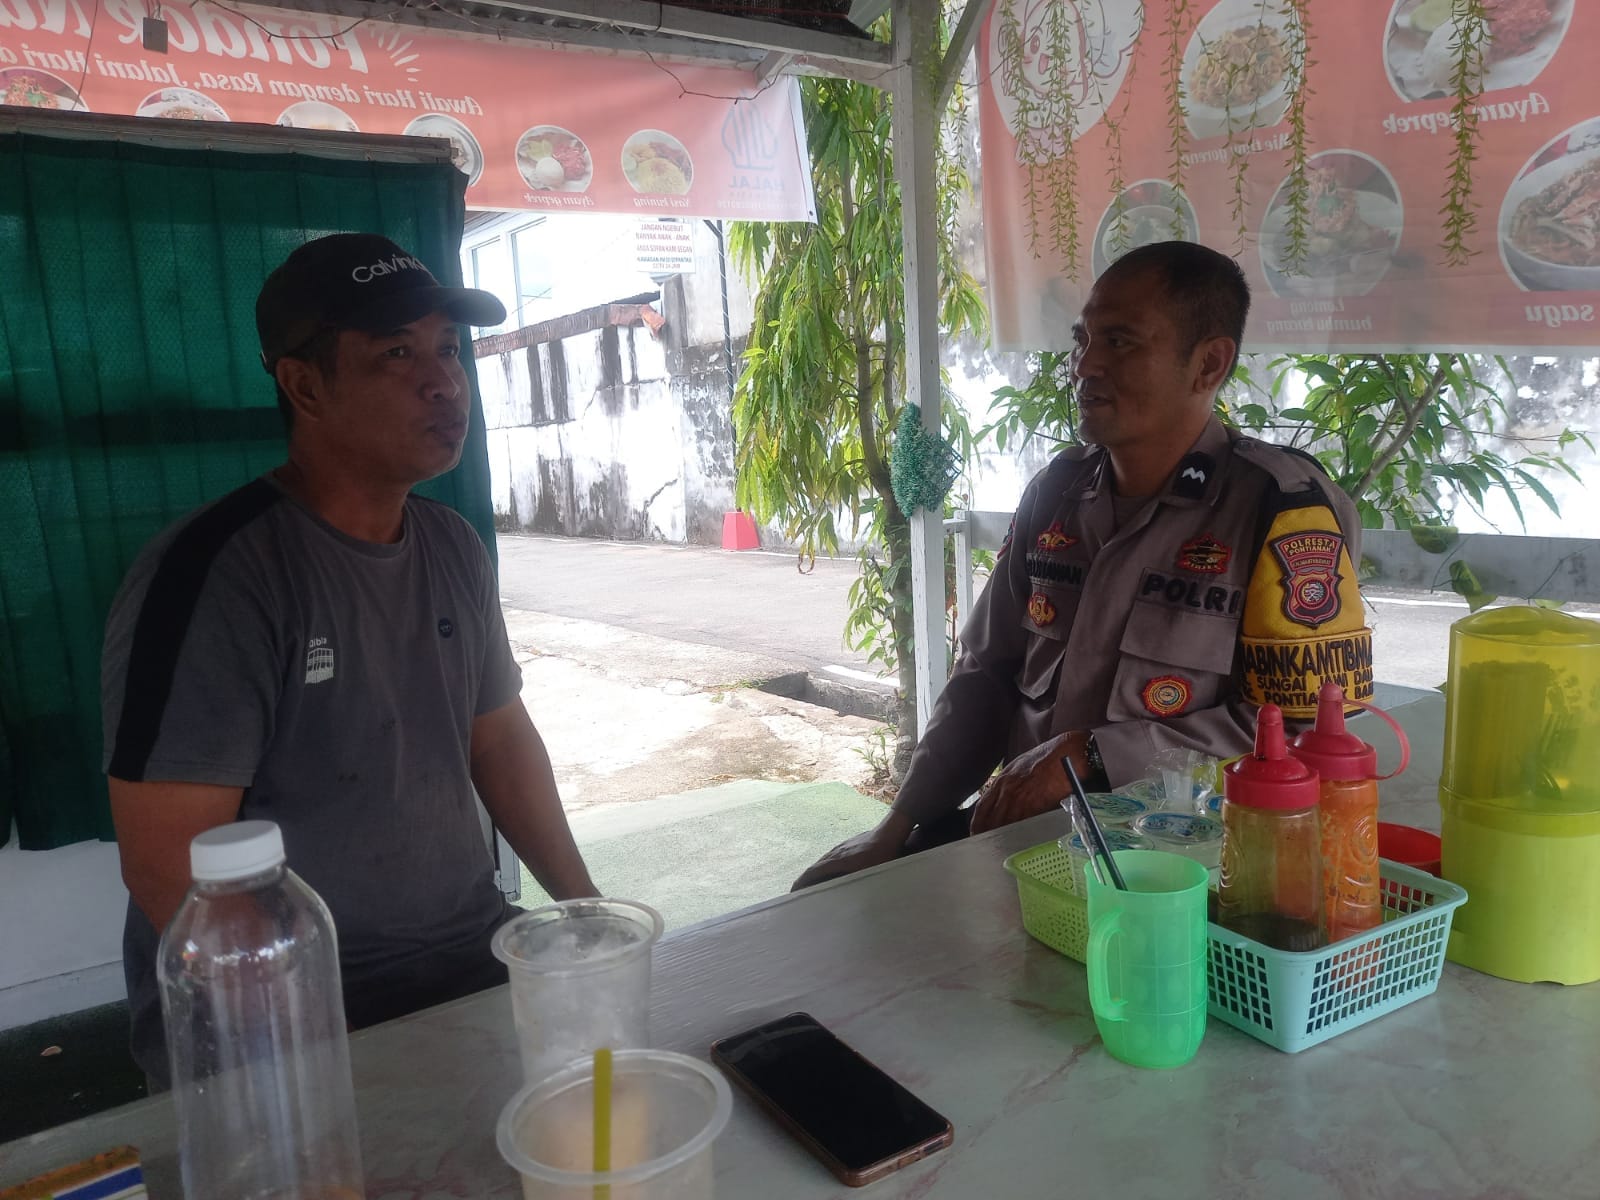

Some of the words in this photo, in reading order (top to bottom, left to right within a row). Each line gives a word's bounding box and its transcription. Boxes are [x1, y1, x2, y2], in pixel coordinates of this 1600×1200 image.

[1283, 538, 1335, 552] POLRESTA
[1288, 546, 1332, 556] PONTIANAK
[1143, 573, 1242, 614] POLRI
[1257, 675, 1308, 692] SUNGAI
